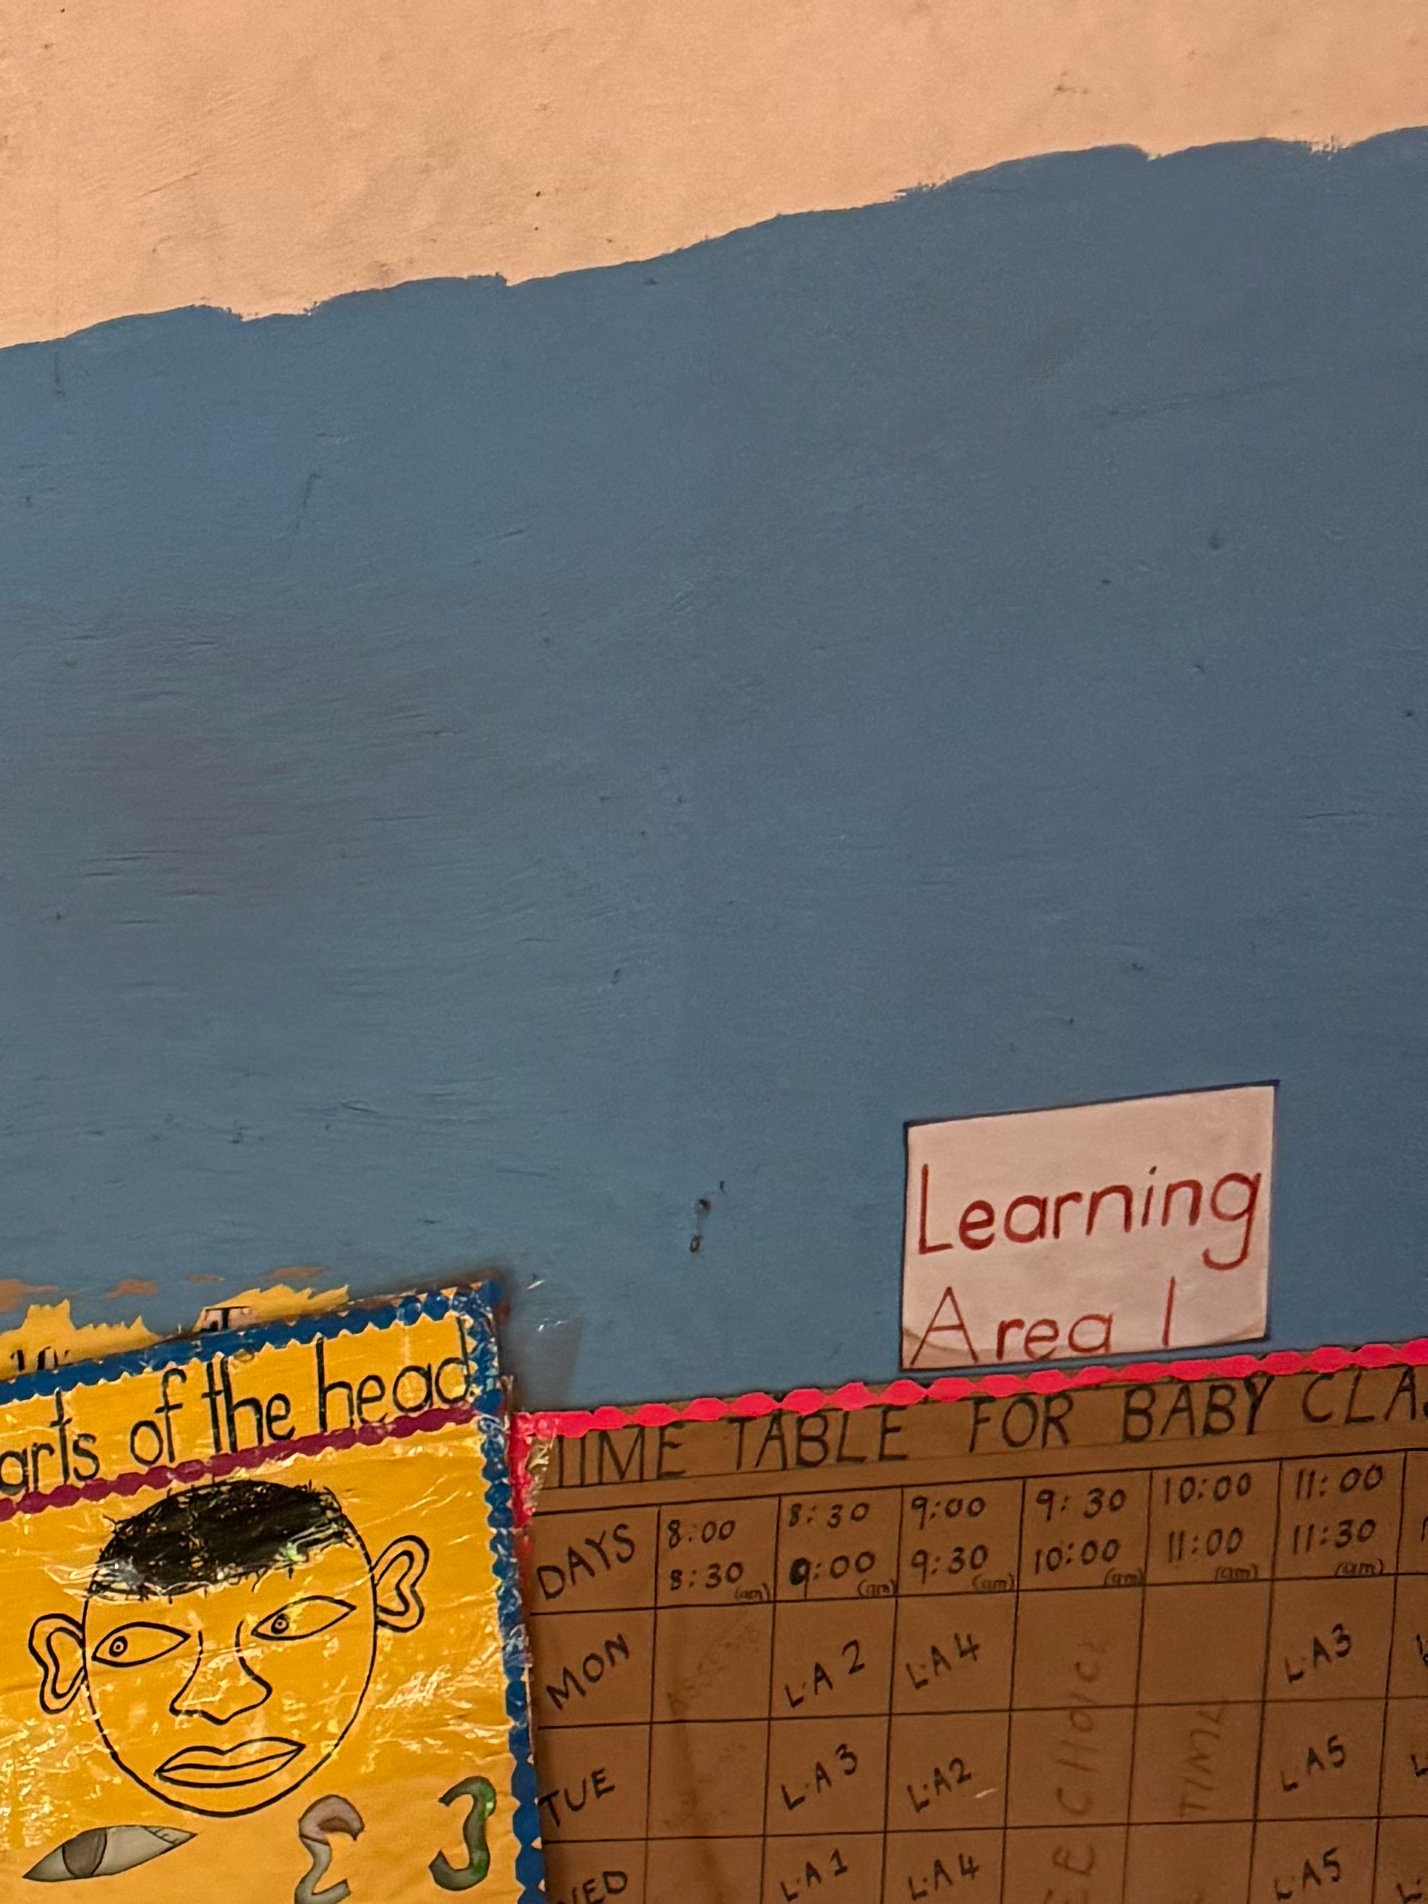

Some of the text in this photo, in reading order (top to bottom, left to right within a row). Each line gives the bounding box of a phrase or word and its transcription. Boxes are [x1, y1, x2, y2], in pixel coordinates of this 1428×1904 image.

[918, 1163, 1262, 1270] Learning
[910, 1275, 1177, 1367] Area 1
[129, 1367, 186, 1467] of
[201, 1355, 296, 1454] the
[316, 1316, 472, 1433] head
[728, 1405, 909, 1472] TABLE
[968, 1394, 1075, 1453] FOR
[1121, 1374, 1273, 1444] BABY
[1301, 1365, 1428, 1424] CLA
[537, 1523, 636, 1599] DAYS
[547, 1634, 630, 1710] MON
[539, 1767, 616, 1828] TUE
